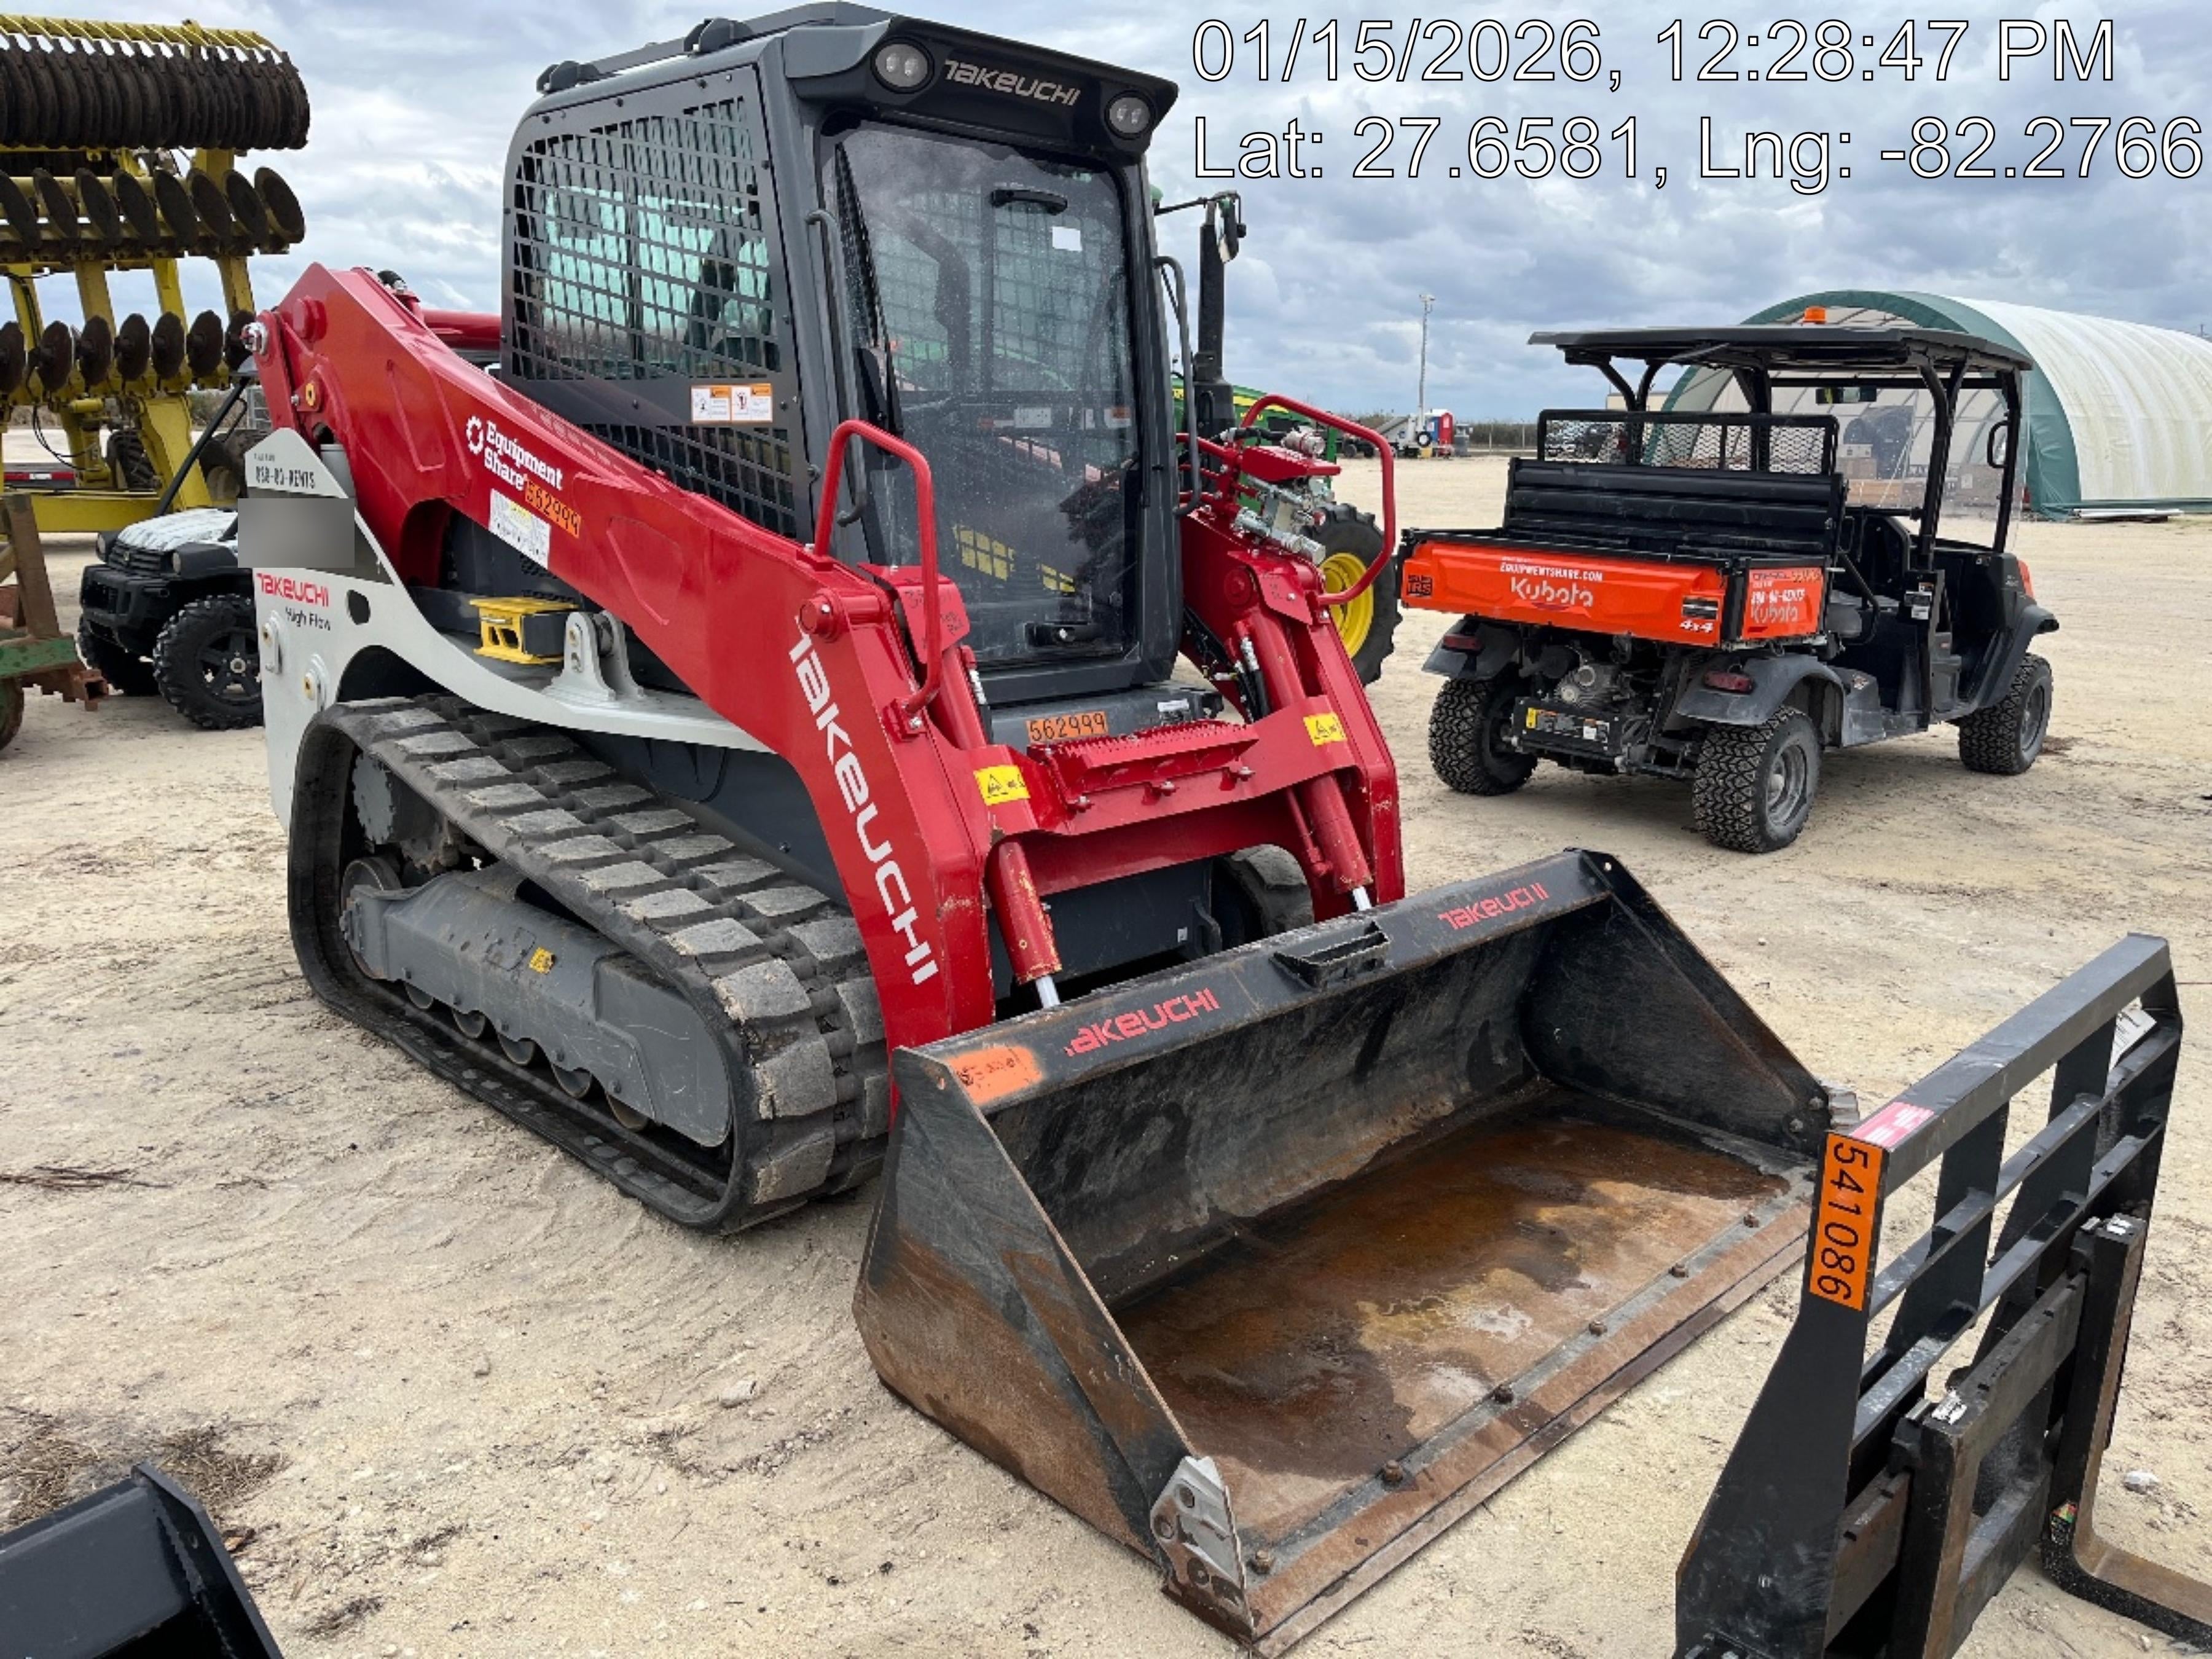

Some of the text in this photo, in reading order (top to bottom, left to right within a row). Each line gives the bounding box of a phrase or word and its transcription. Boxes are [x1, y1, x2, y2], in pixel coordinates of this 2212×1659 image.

[945, 60, 1081, 106] TAKEUCHI
[484, 446, 527, 491] Share
[486, 420, 563, 490] Equipment
[526, 480, 578, 536] 562999
[1500, 560, 1603, 582] EQUIPMENTSHARE.COM
[256, 573, 329, 608] TAKEUCHI
[1511, 576, 1593, 607] Kubota
[285, 606, 307, 627] High
[1680, 619, 1713, 633] 4x4
[1029, 712, 1105, 742] 562999
[1817, 1142, 1869, 1301] 541086
